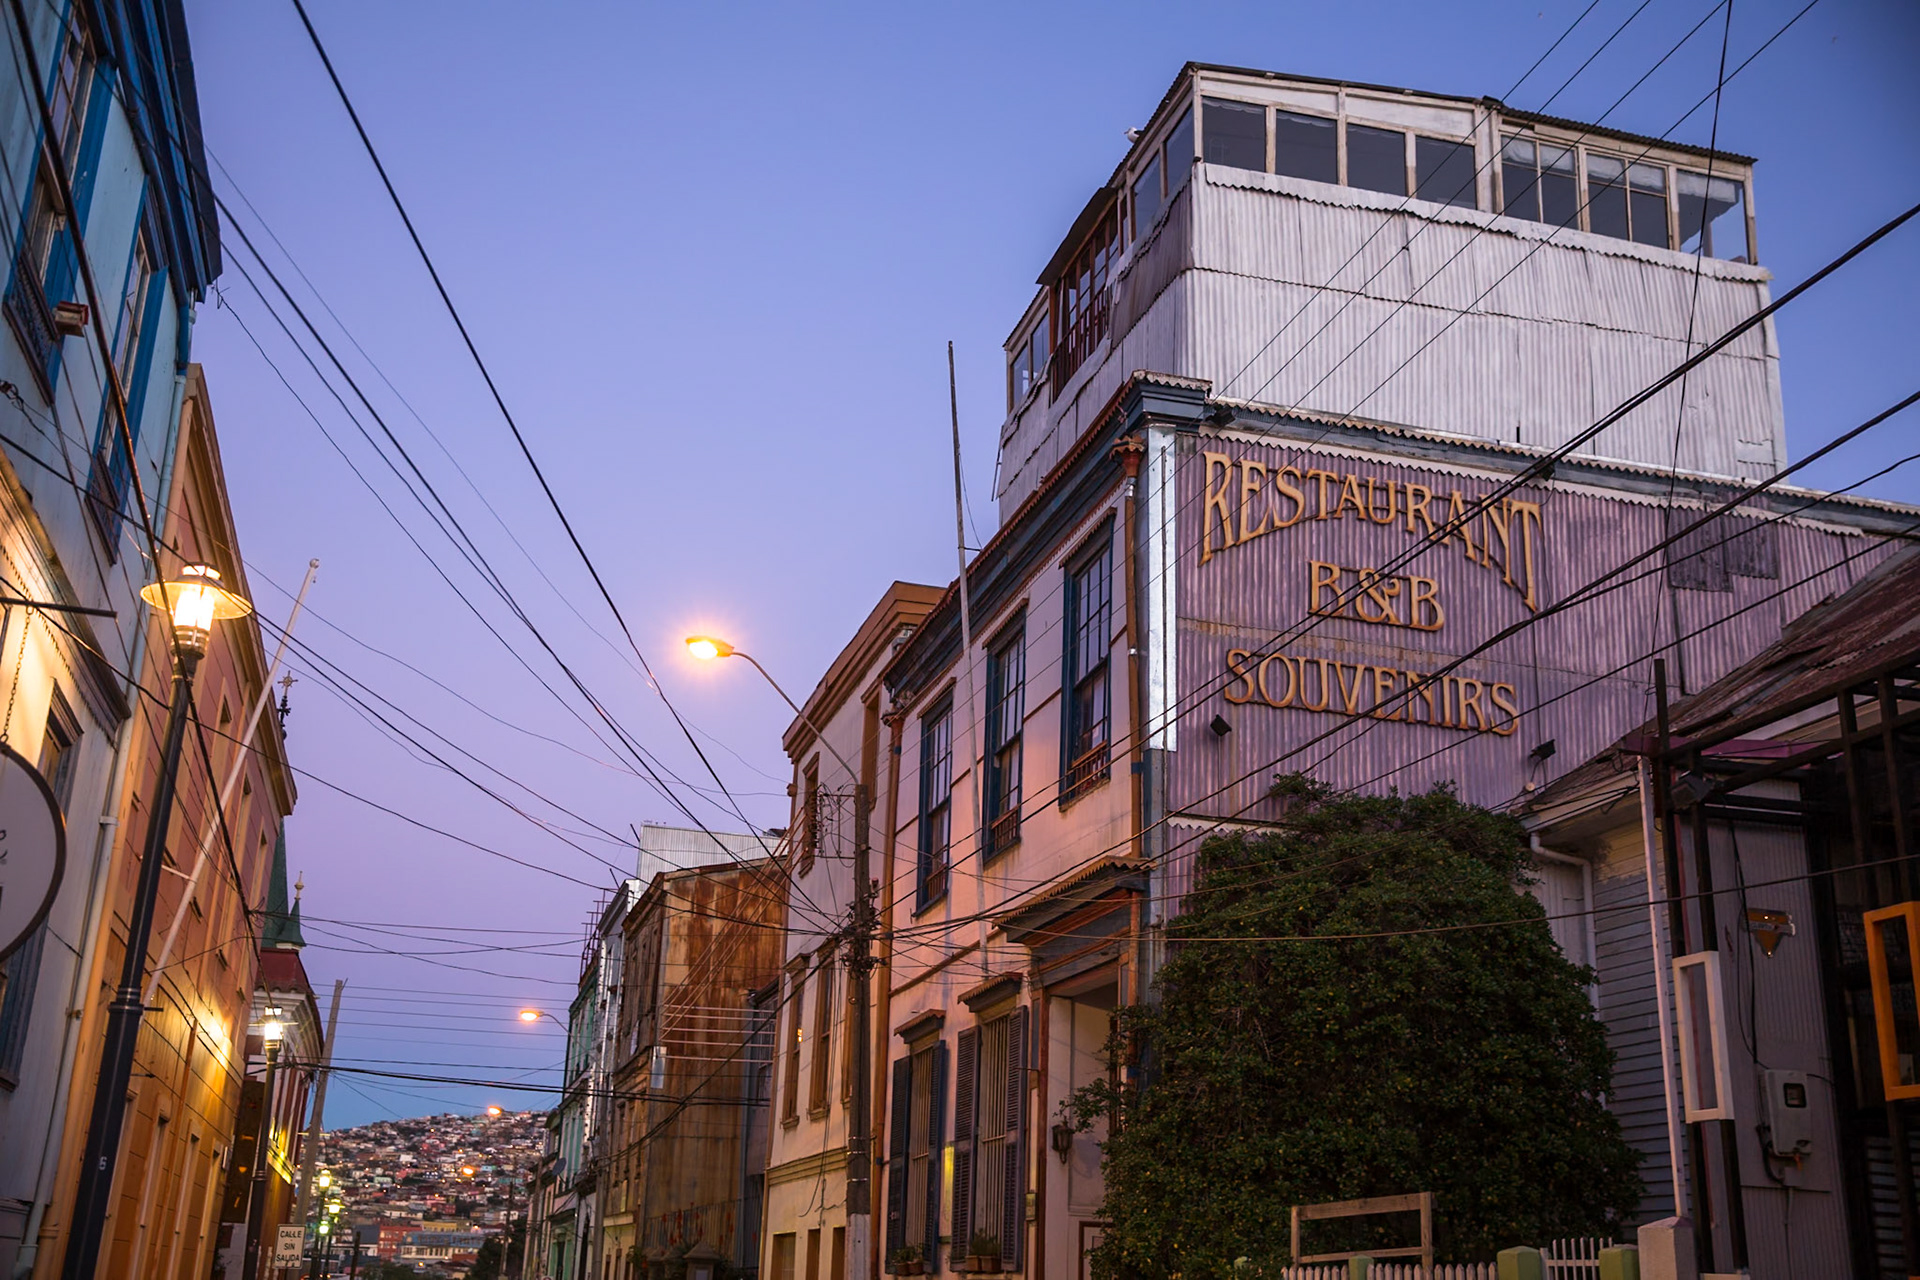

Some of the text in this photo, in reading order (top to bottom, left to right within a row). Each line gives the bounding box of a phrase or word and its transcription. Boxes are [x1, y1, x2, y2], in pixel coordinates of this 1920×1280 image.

[1199, 451, 1543, 613] RESTAURANT
[1309, 560, 1445, 632] B&B
[1223, 648, 1519, 737] SOUVENIRS
[280, 1230, 302, 1238] CALLE
[284, 1242, 296, 1250] SIN
[275, 1253, 300, 1262] SALIDA
